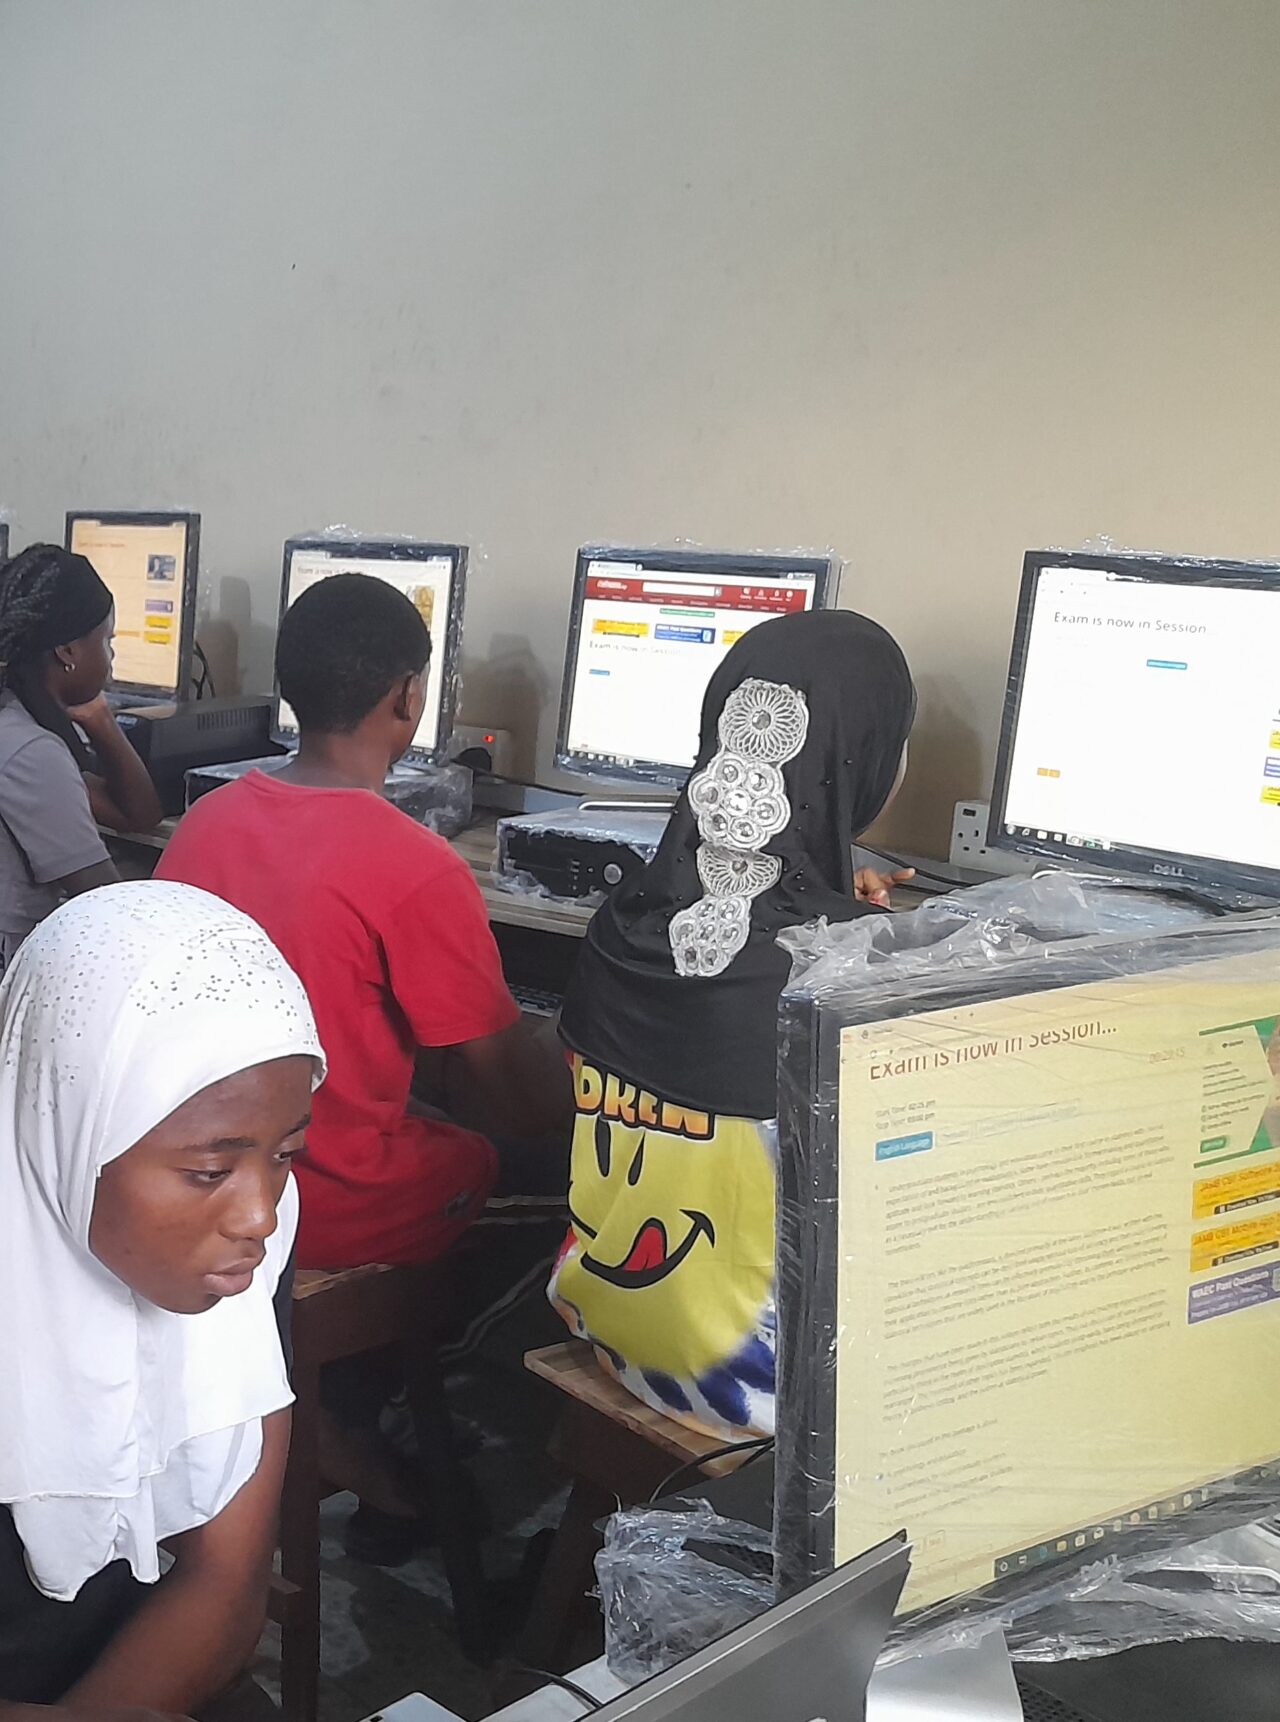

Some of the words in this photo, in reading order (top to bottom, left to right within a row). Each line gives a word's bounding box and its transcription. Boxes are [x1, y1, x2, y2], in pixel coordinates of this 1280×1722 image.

[1053, 611, 1089, 624] Exam
[1092, 616, 1103, 626] is
[1107, 617, 1135, 629] now
[1138, 620, 1151, 630] in
[1154, 864, 1185, 877] DELL
[870, 1055, 927, 1080] Exam
[934, 1052, 950, 1068] is
[956, 1041, 998, 1063] now
[1005, 1036, 1022, 1053] in
